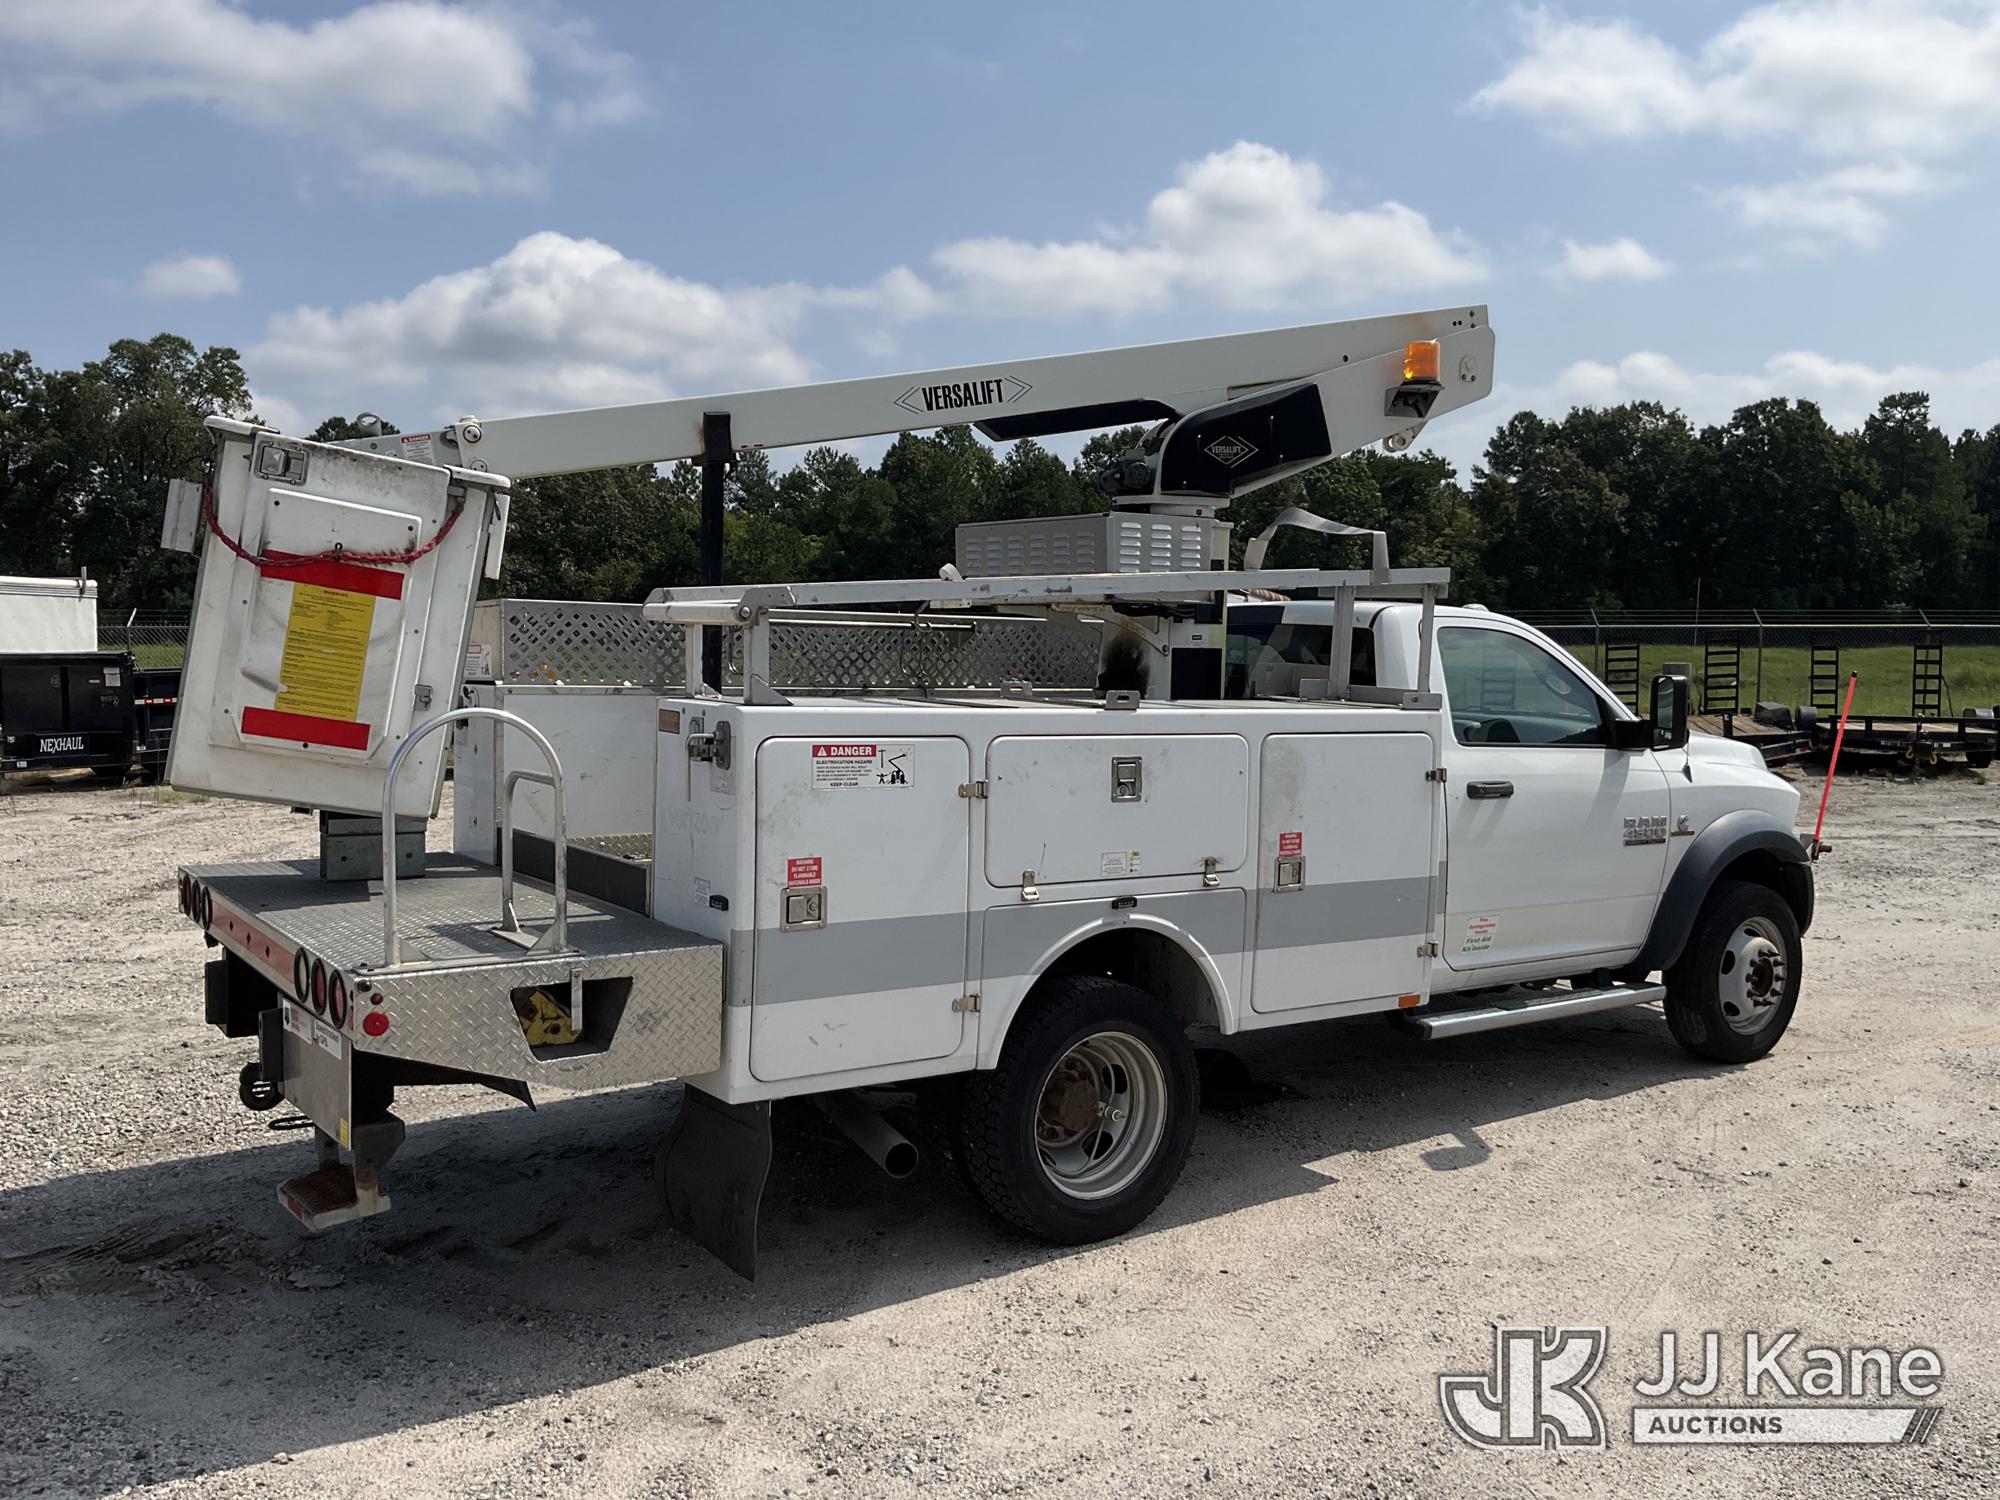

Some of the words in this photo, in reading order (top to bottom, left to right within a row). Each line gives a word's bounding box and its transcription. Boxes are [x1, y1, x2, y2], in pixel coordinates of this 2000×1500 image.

[922, 379, 1003, 412] VERSALIFT
[1211, 445, 1241, 454] VERSALIFT
[40, 736, 84, 754] NEXHAUL
[830, 746, 872, 756] DANGER
[1624, 816, 1668, 829] RAM
[1623, 828, 1667, 839] 4500
